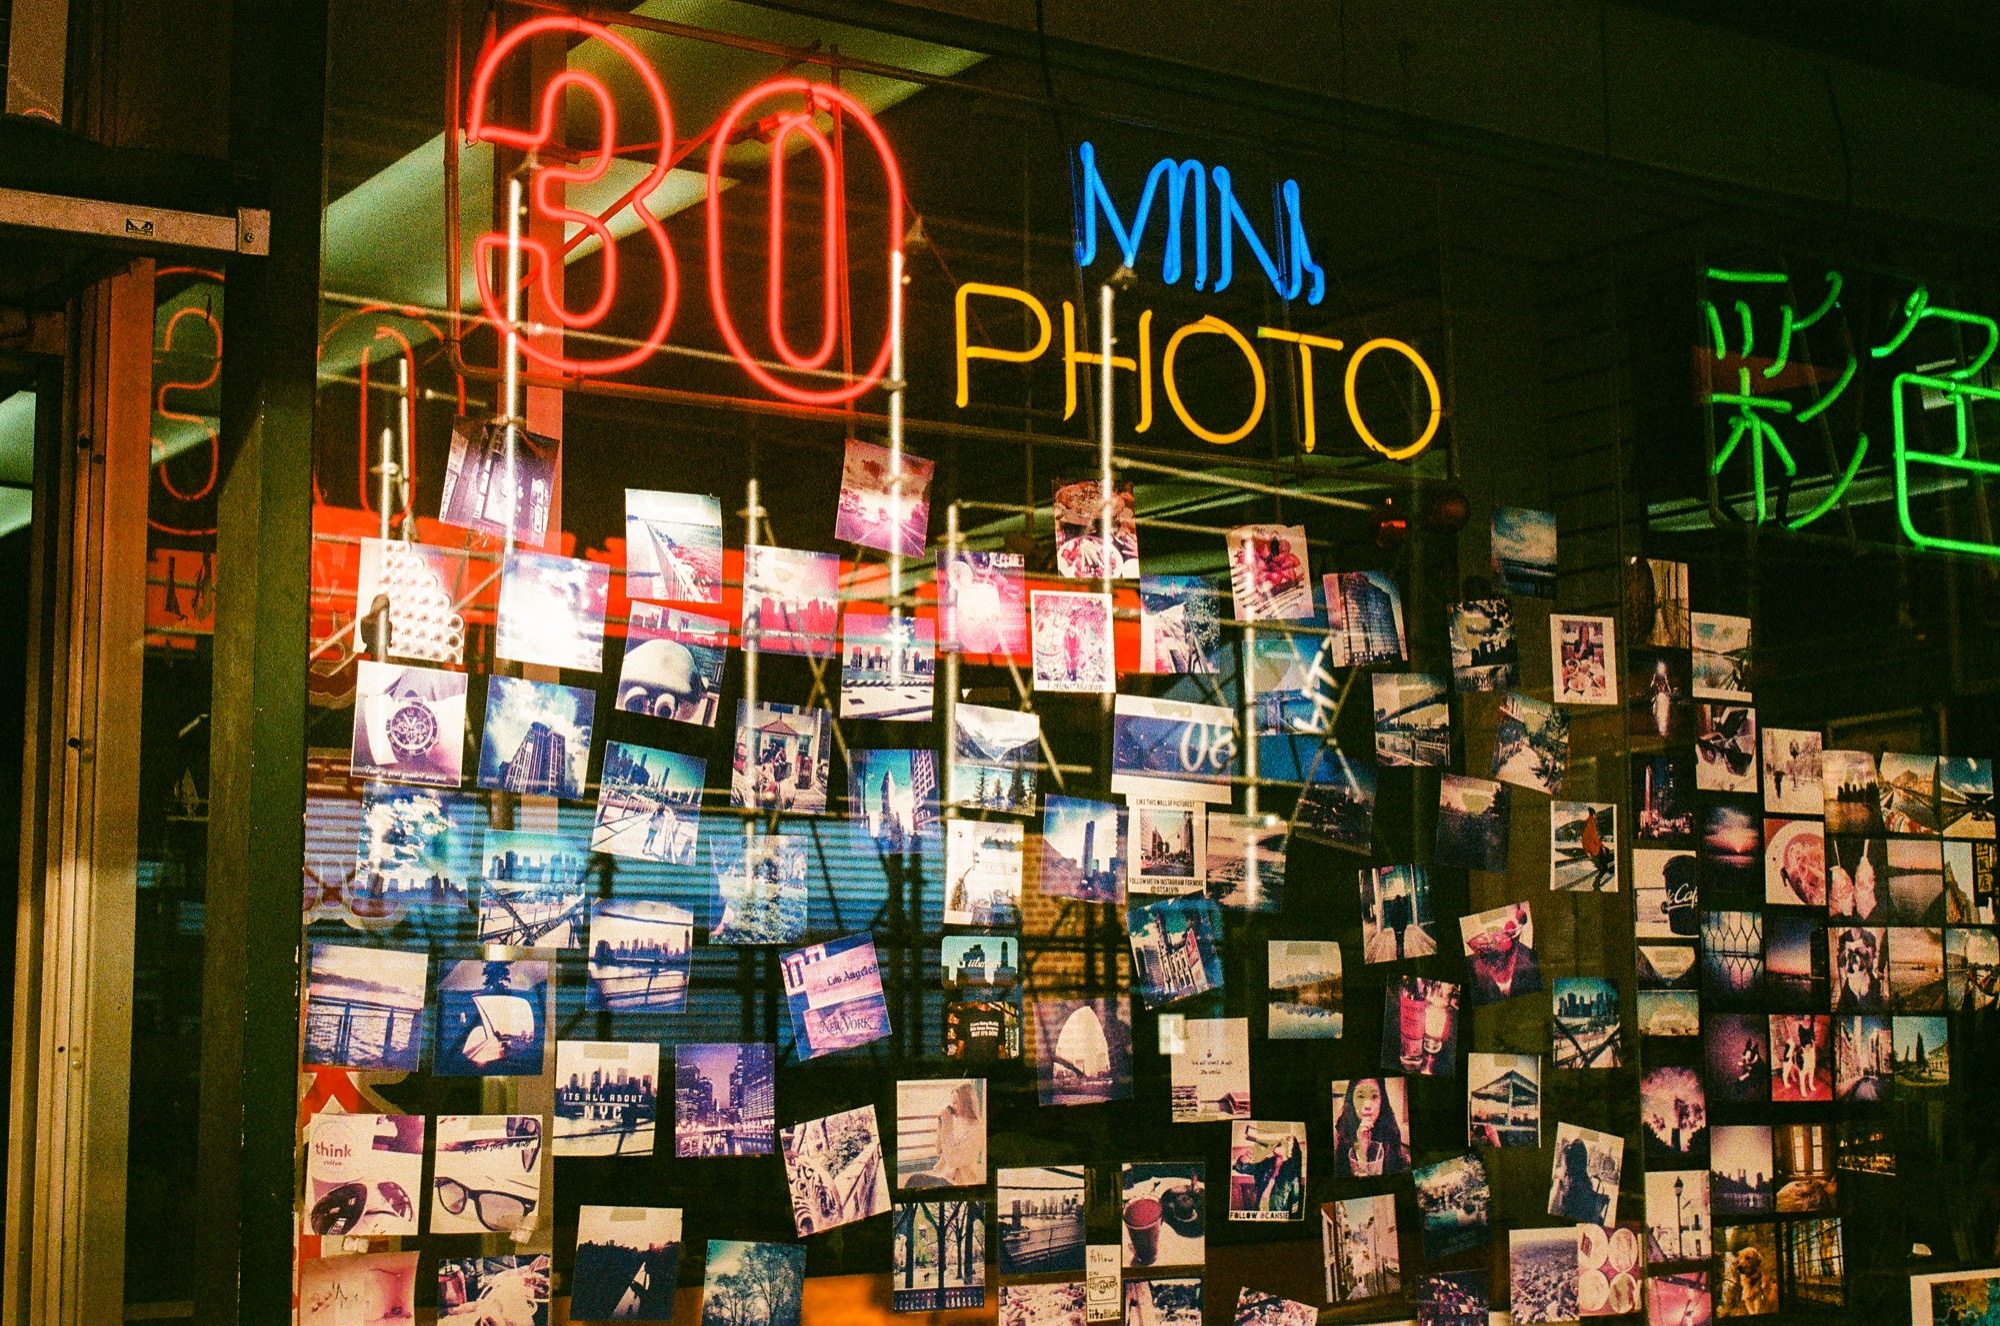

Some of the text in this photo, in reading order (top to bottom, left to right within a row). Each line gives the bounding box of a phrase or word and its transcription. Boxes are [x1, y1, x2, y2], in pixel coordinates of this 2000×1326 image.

[464, 14, 907, 406] 30
[955, 281, 1442, 461] PHOTO
[1157, 799, 1168, 807] WALL
[1129, 877, 1146, 885] FOLLOW
[1154, 878, 1160, 886] ON
[1160, 878, 1184, 886] INSTAGRAM
[563, 1092, 643, 1103] ITS ALL ABOUT
[584, 1105, 622, 1120] NYC
[315, 1142, 352, 1158] think
[1229, 1211, 1258, 1220] FOLLOW
